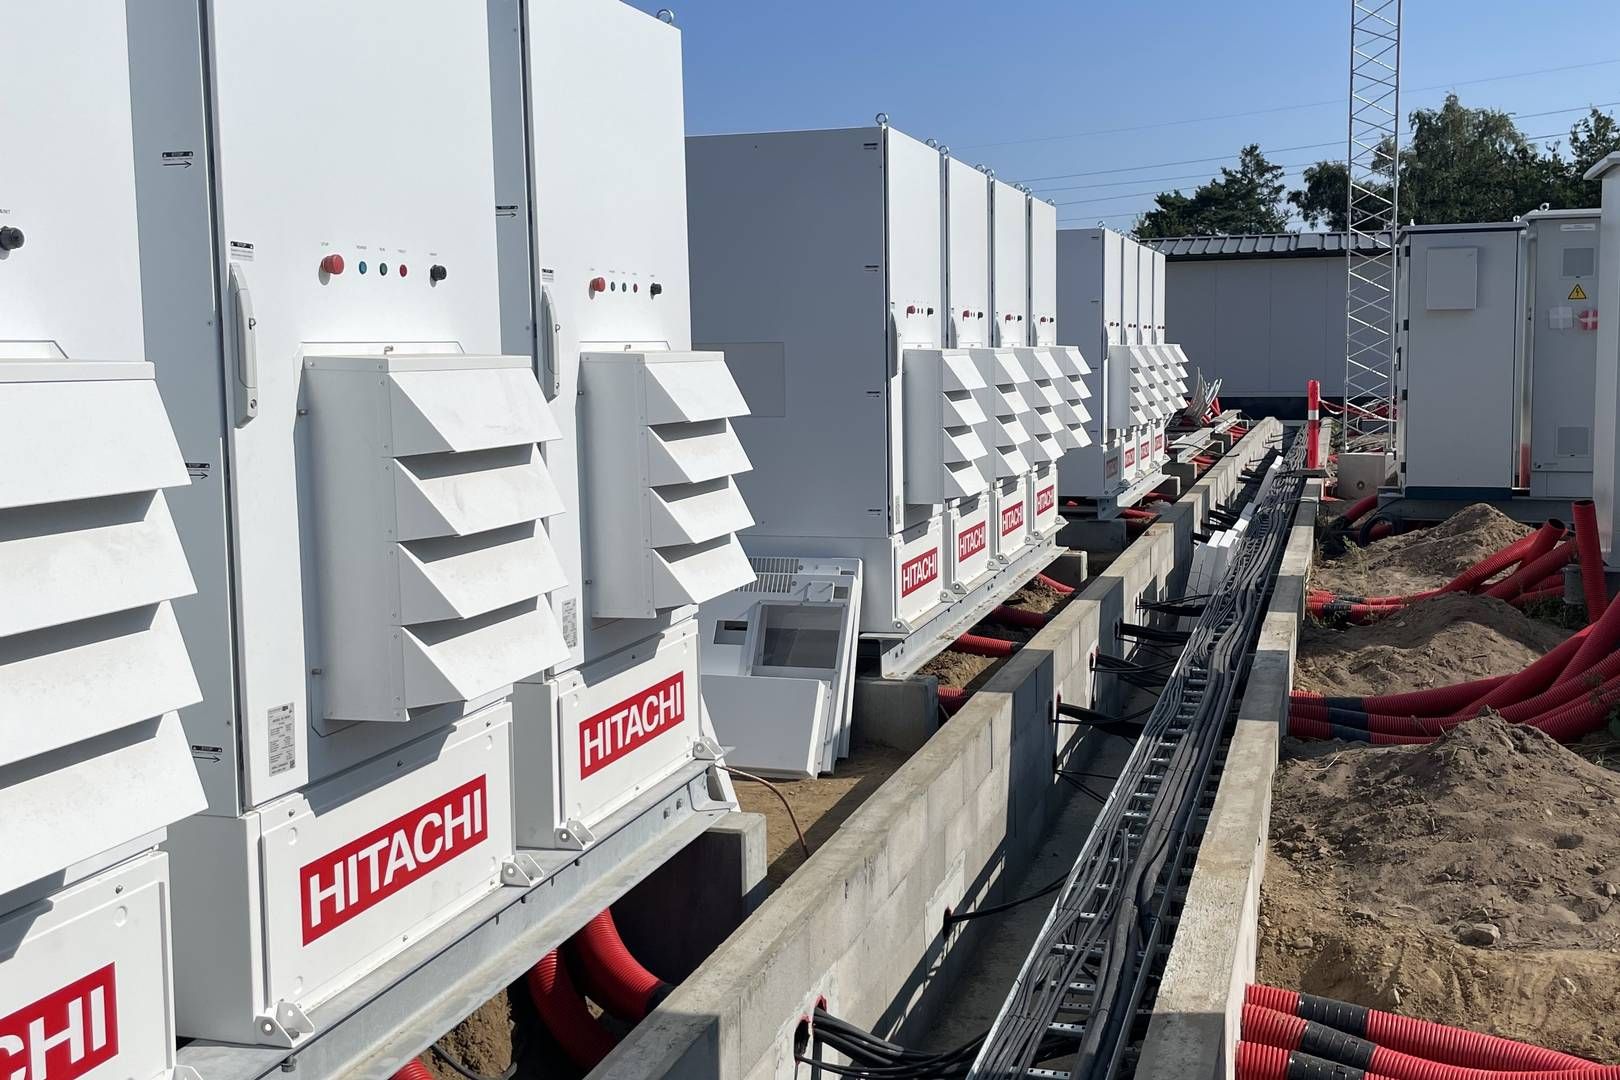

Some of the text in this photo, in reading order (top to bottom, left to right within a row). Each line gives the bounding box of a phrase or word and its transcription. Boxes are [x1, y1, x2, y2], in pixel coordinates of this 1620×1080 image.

[1002, 505, 1023, 533] HITACHI
[959, 526, 985, 558] HITACHI
[902, 553, 937, 591] HITACHI
[583, 681, 682, 768] HITACHI
[309, 788, 483, 928] HITACHI
